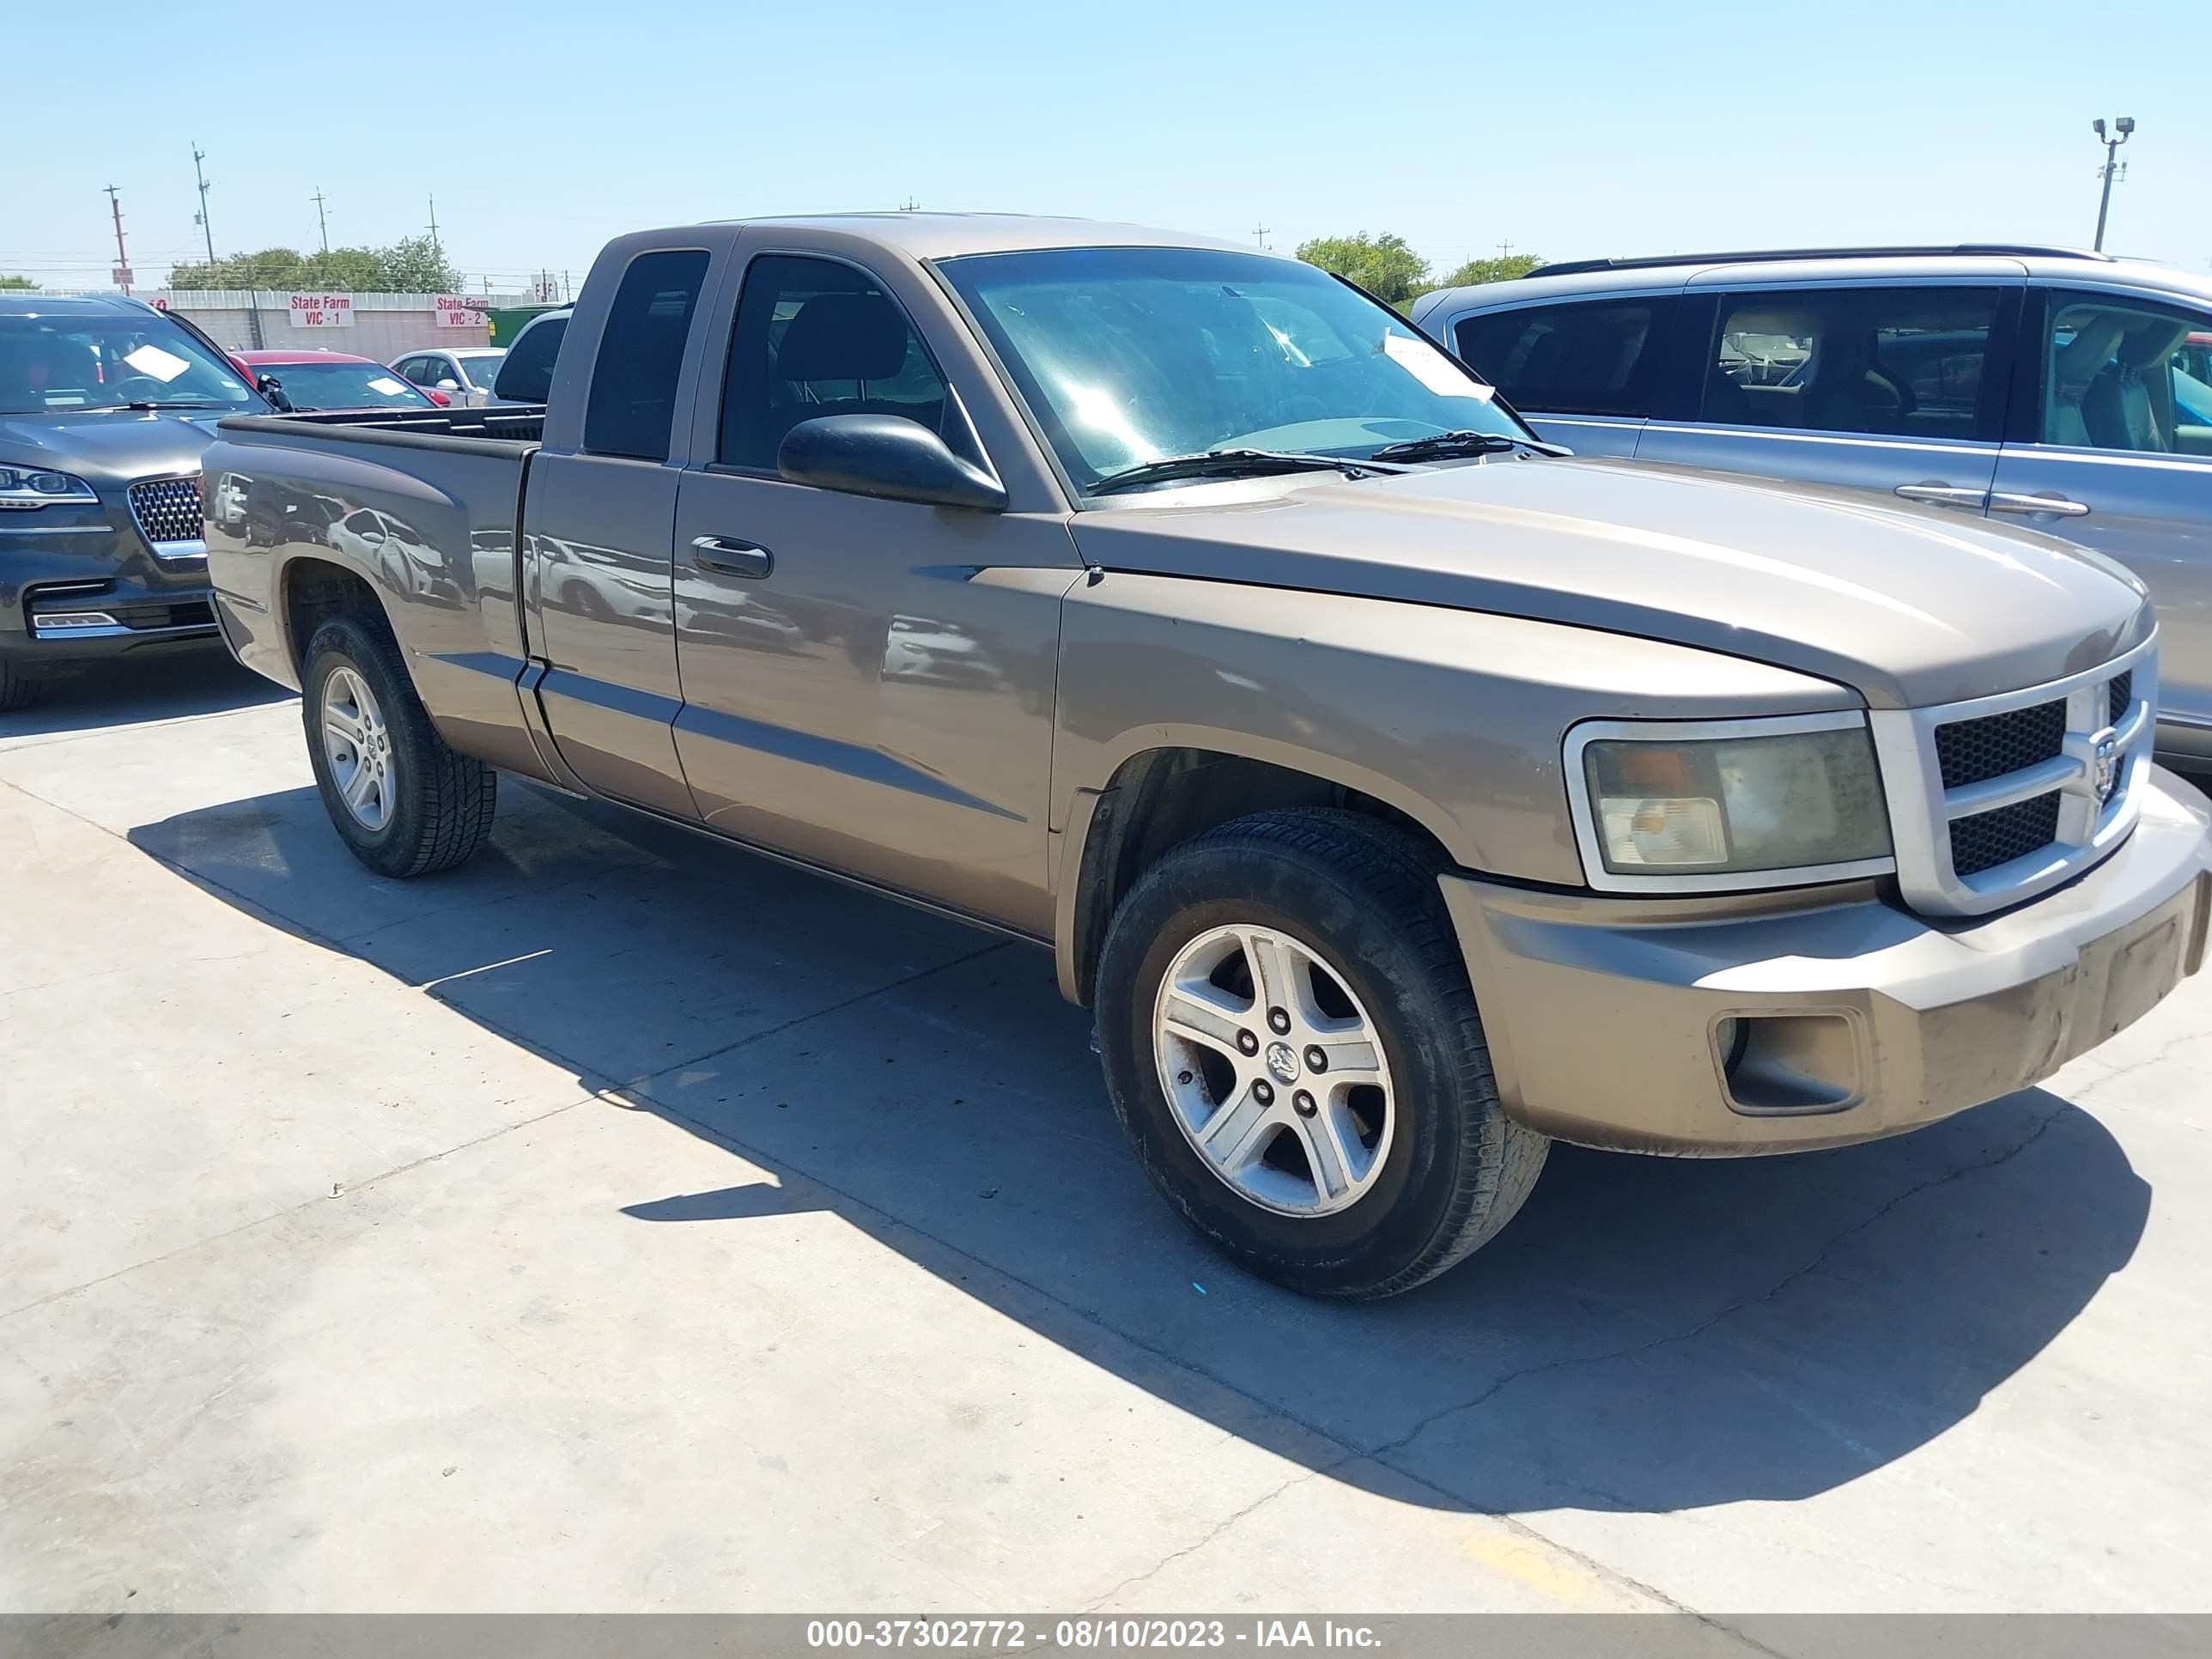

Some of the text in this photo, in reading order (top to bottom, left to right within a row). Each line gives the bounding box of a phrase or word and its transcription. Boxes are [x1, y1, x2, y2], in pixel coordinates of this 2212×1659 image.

[292, 295, 349, 309] State Farm
[437, 297, 488, 310] State Farm
[306, 312, 323, 325] VIC
[335, 312, 339, 325] 1
[449, 312, 465, 325] VIC
[475, 312, 481, 325] 2
